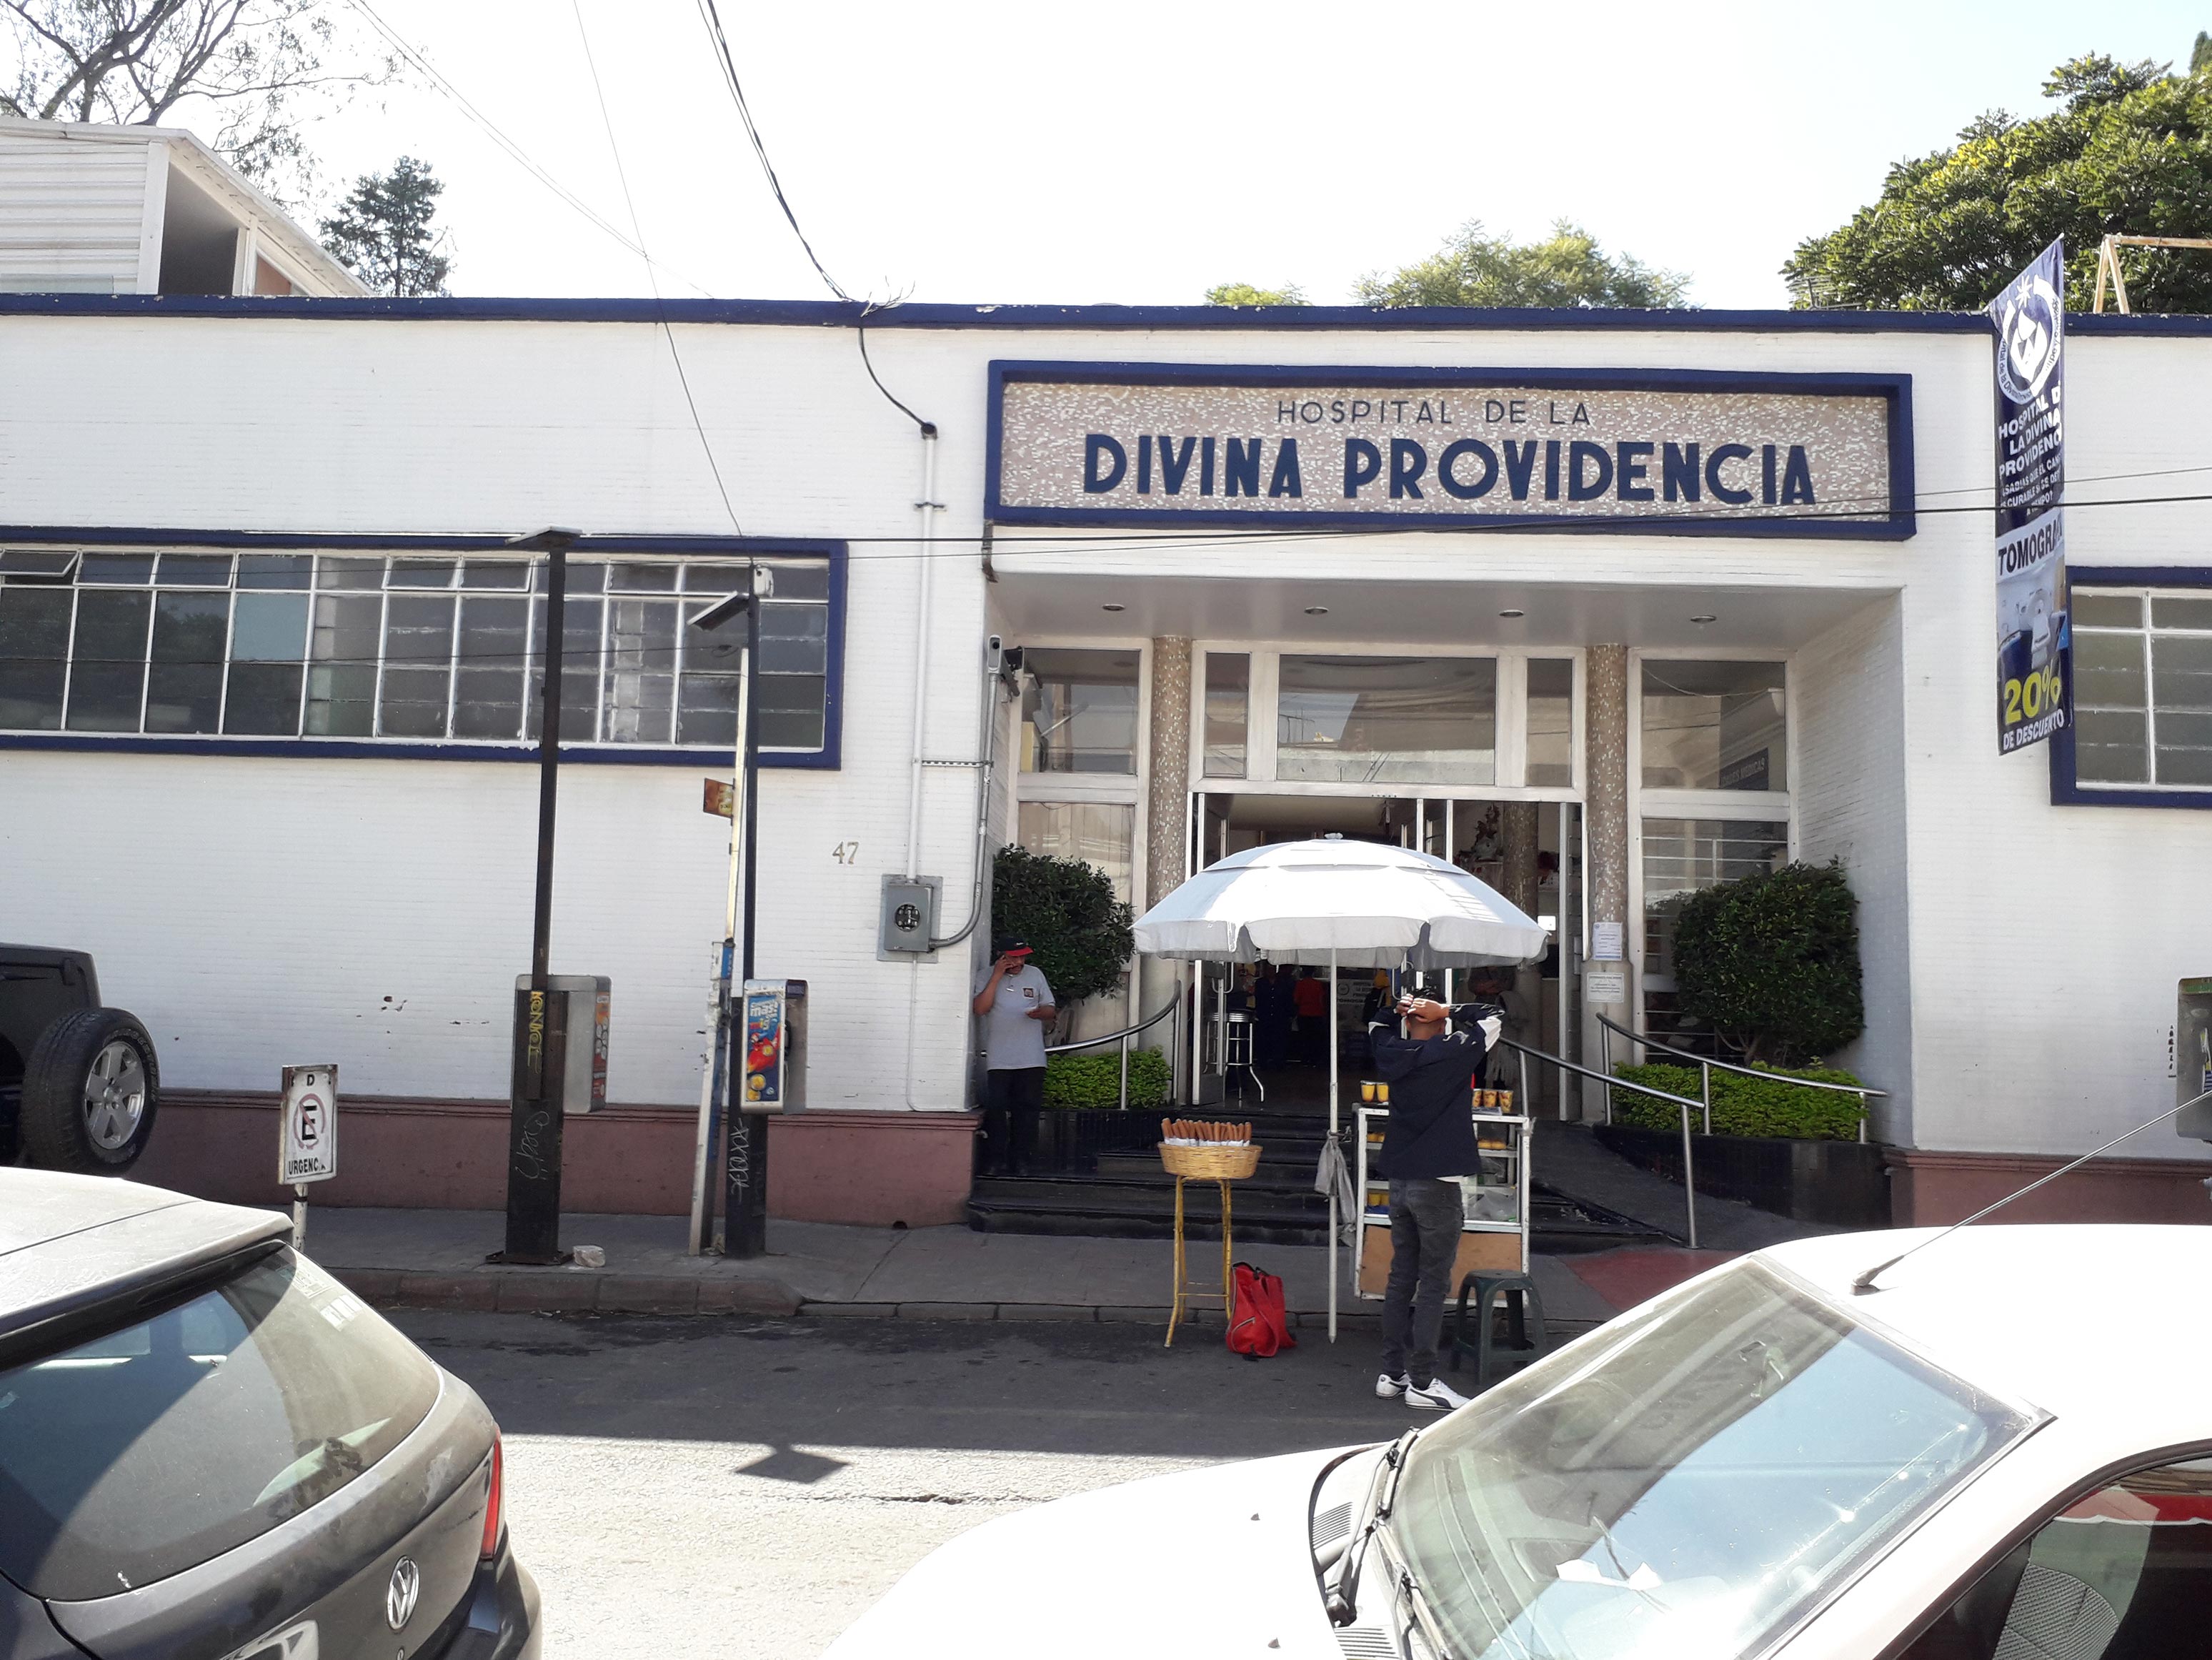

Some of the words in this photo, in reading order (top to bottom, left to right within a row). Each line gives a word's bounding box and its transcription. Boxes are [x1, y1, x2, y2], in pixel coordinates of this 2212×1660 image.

[1277, 400, 1451, 424] HOSPITAL
[1485, 399, 1527, 424] DE
[1550, 402, 1592, 426] LA
[1998, 394, 2048, 439] HOSPITAL
[2010, 435, 2025, 455] LA
[2026, 407, 2061, 444] DIVINA
[1083, 433, 1303, 499] DIVINA
[1343, 437, 1817, 506] PROVIDENCIA
[2039, 463, 2046, 475] EL
[2007, 486, 2036, 507] CURABLE
[2004, 657, 2061, 726] 20%
[2003, 730, 2014, 750] DE
[2016, 708, 2064, 745] DESCUENTO
[832, 841, 859, 865] 47
[302, 1105, 317, 1140] E
